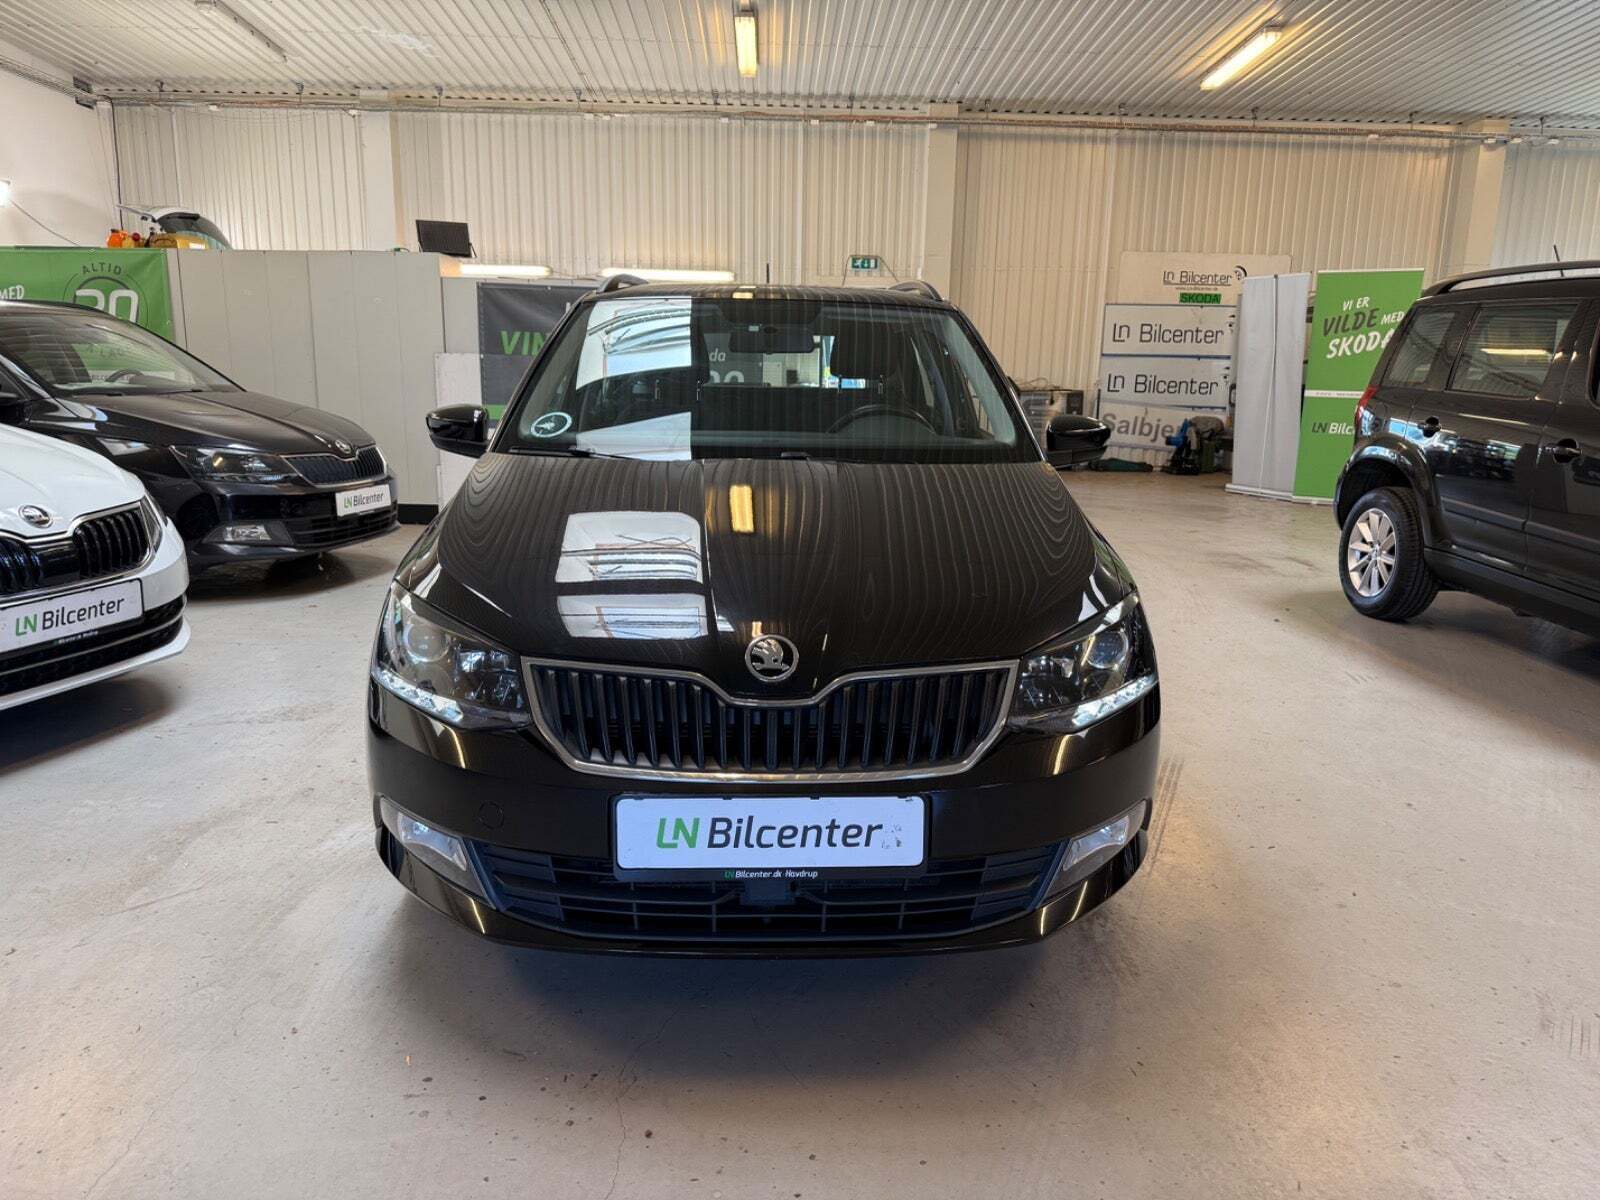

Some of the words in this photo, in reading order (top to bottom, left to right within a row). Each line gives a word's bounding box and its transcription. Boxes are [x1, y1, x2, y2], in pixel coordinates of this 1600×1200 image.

[82, 262, 122, 275] ALTID
[1180, 271, 1232, 285] Bilcenter
[1343, 300, 1353, 311] VI
[1356, 296, 1370, 309] ER
[1323, 307, 1379, 337] VILDE
[1381, 311, 1405, 325] MED
[1139, 323, 1224, 344] Bilcenter
[1134, 374, 1218, 395] Bilcenter
[1328, 422, 1355, 435] Bilc
[353, 493, 384, 507] Bilcenter
[15, 614, 38, 637] LN
[42, 598, 125, 630] Bilcenter
[656, 817, 700, 849] LN
[707, 815, 883, 849] Bilcenter
